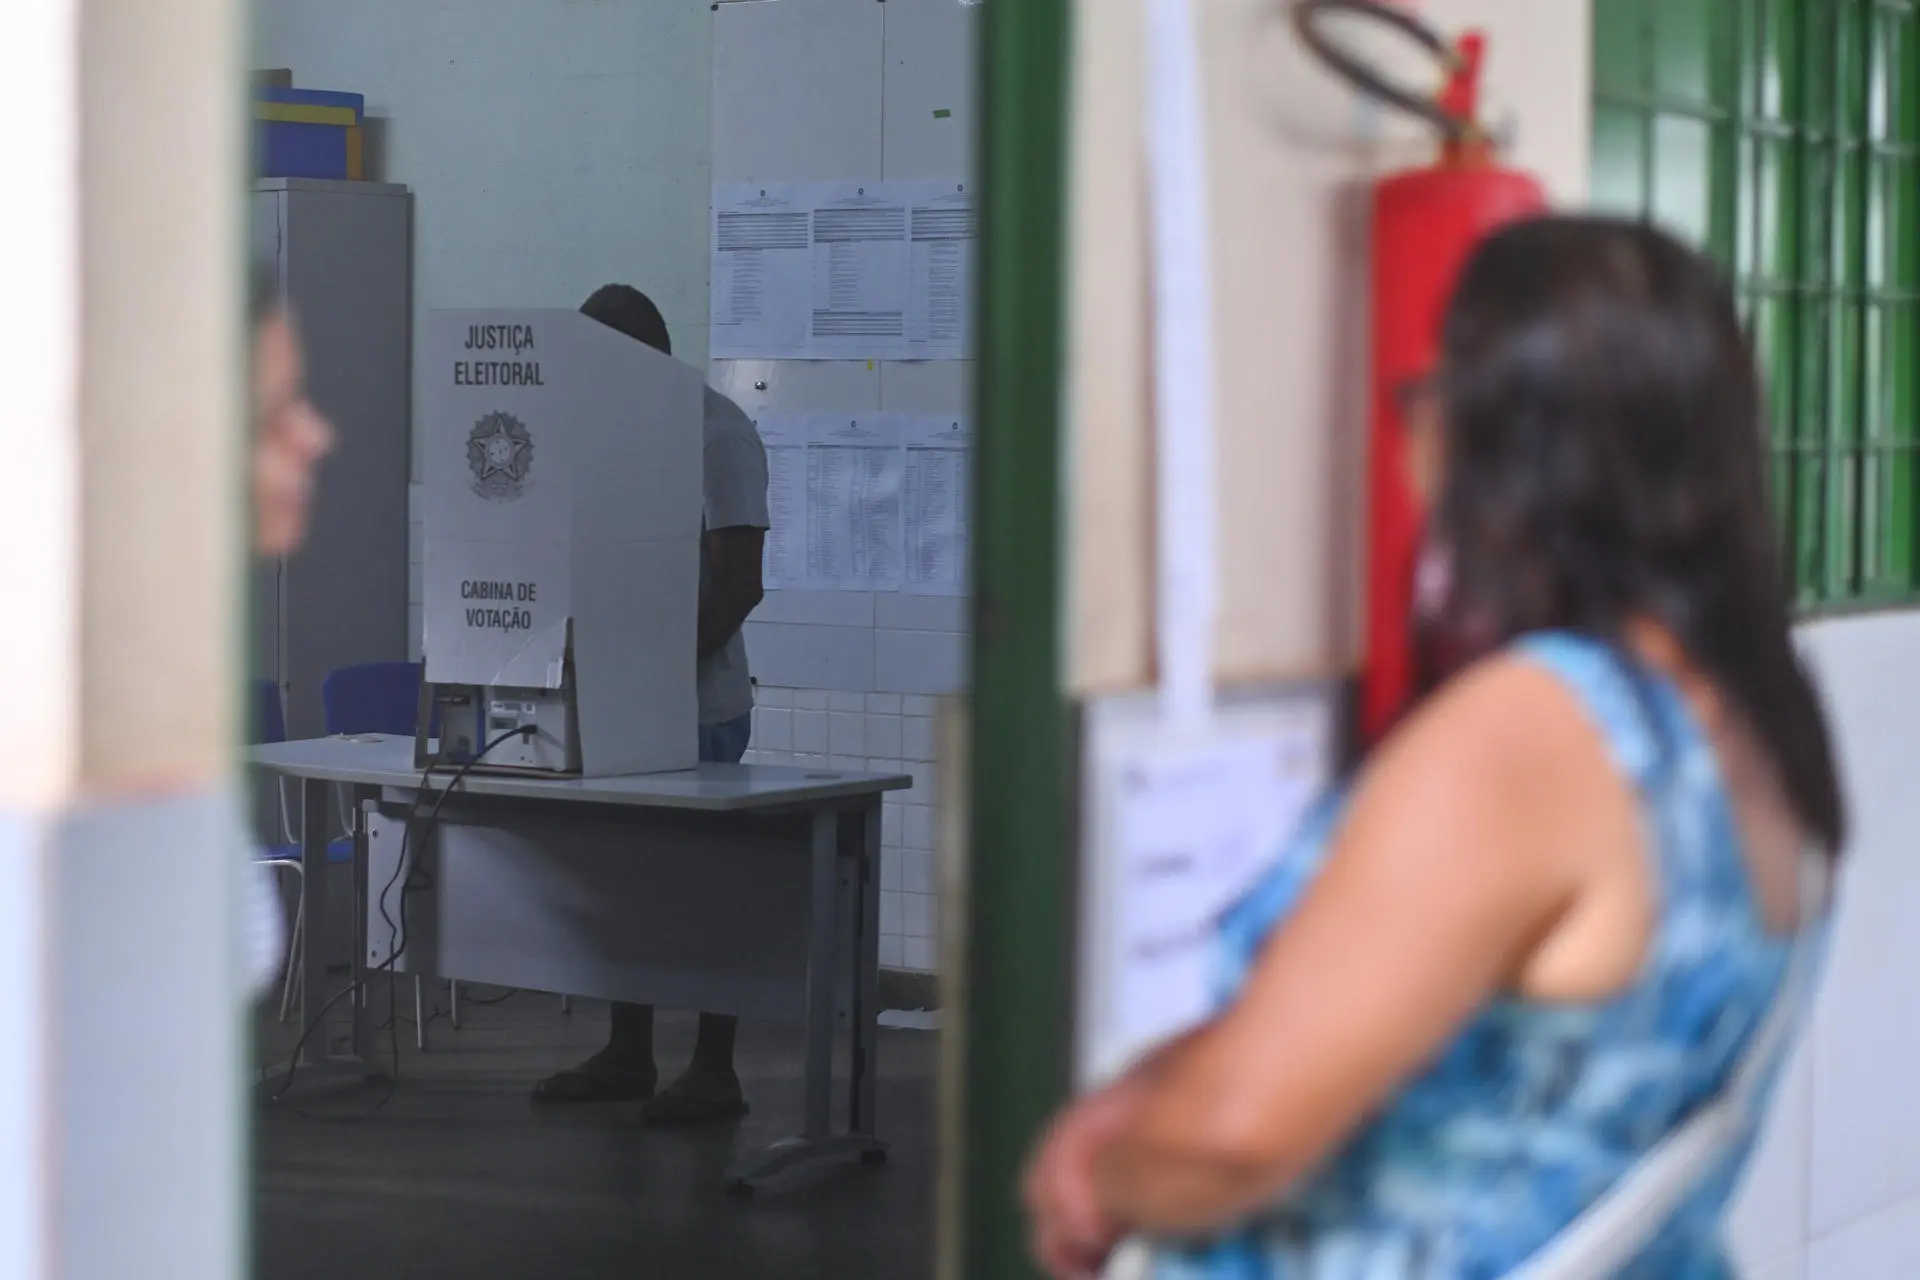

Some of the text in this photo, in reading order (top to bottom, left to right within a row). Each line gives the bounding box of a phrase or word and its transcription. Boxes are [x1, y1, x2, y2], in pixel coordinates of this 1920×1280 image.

[464, 324, 534, 356] JUSTIÇA
[454, 361, 545, 386] ELEITORAL
[461, 580, 537, 602] CABINA DE
[465, 606, 532, 634] VOTAÇÃO
